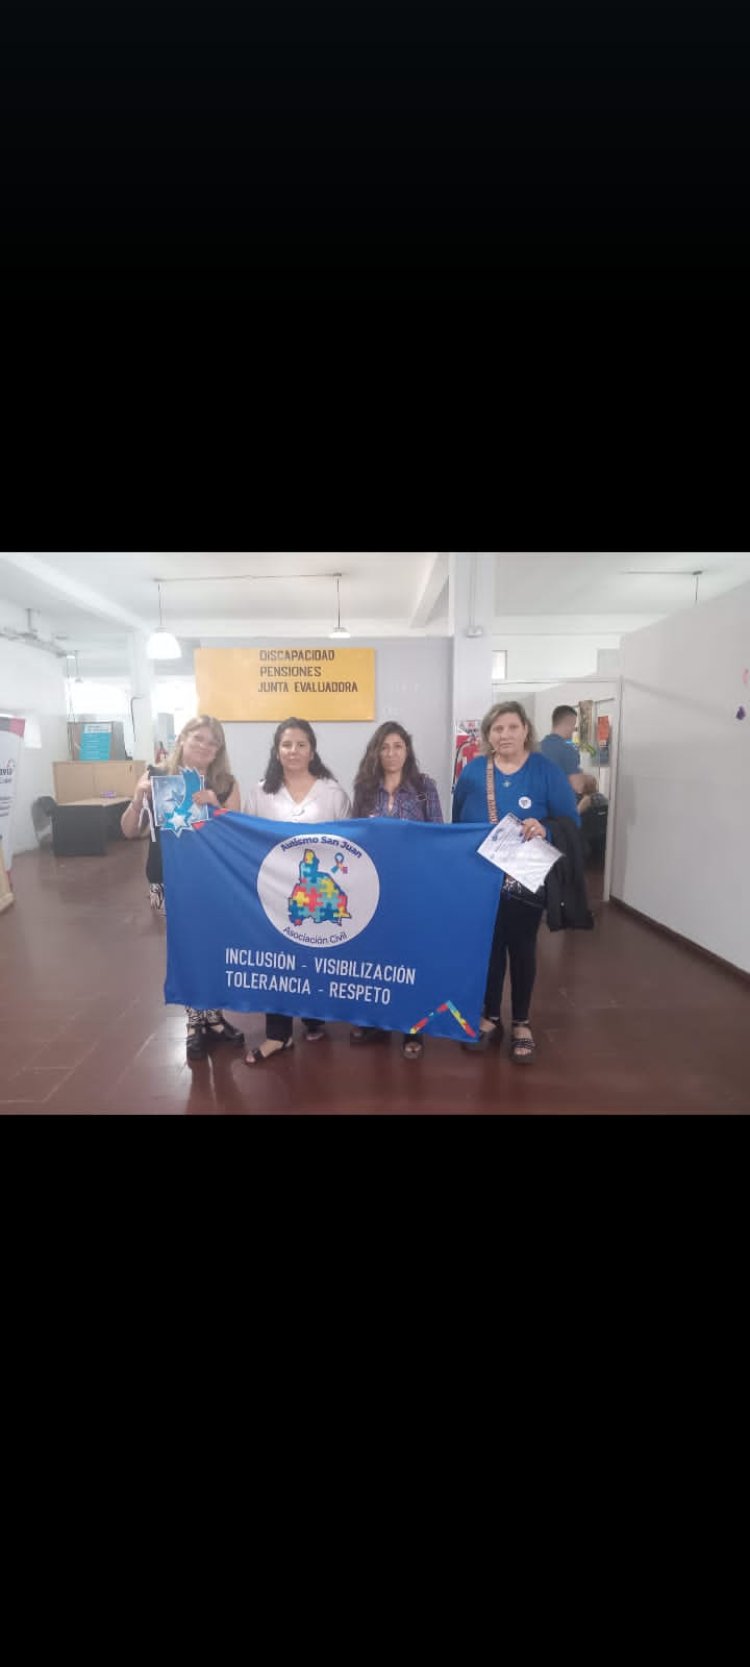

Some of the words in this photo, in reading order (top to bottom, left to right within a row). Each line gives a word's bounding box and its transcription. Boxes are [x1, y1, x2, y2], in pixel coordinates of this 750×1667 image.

[259, 649, 335, 661] DISCAPACIDAD
[260, 666, 322, 677] PENSIONES
[257, 681, 289, 693] JUNTA
[294, 681, 358, 693] EVALUADORA
[280, 836, 319, 852] Autismo
[320, 836, 340, 846] San
[340, 841, 363, 859] Juan
[329, 931, 348, 944] Civil
[225, 948, 297, 971] INCLUSIÓN
[314, 957, 416, 985] VISIBILIZACIÓN
[225, 970, 311, 995] TOLERANCIA
[329, 981, 391, 1005] RESPETO
